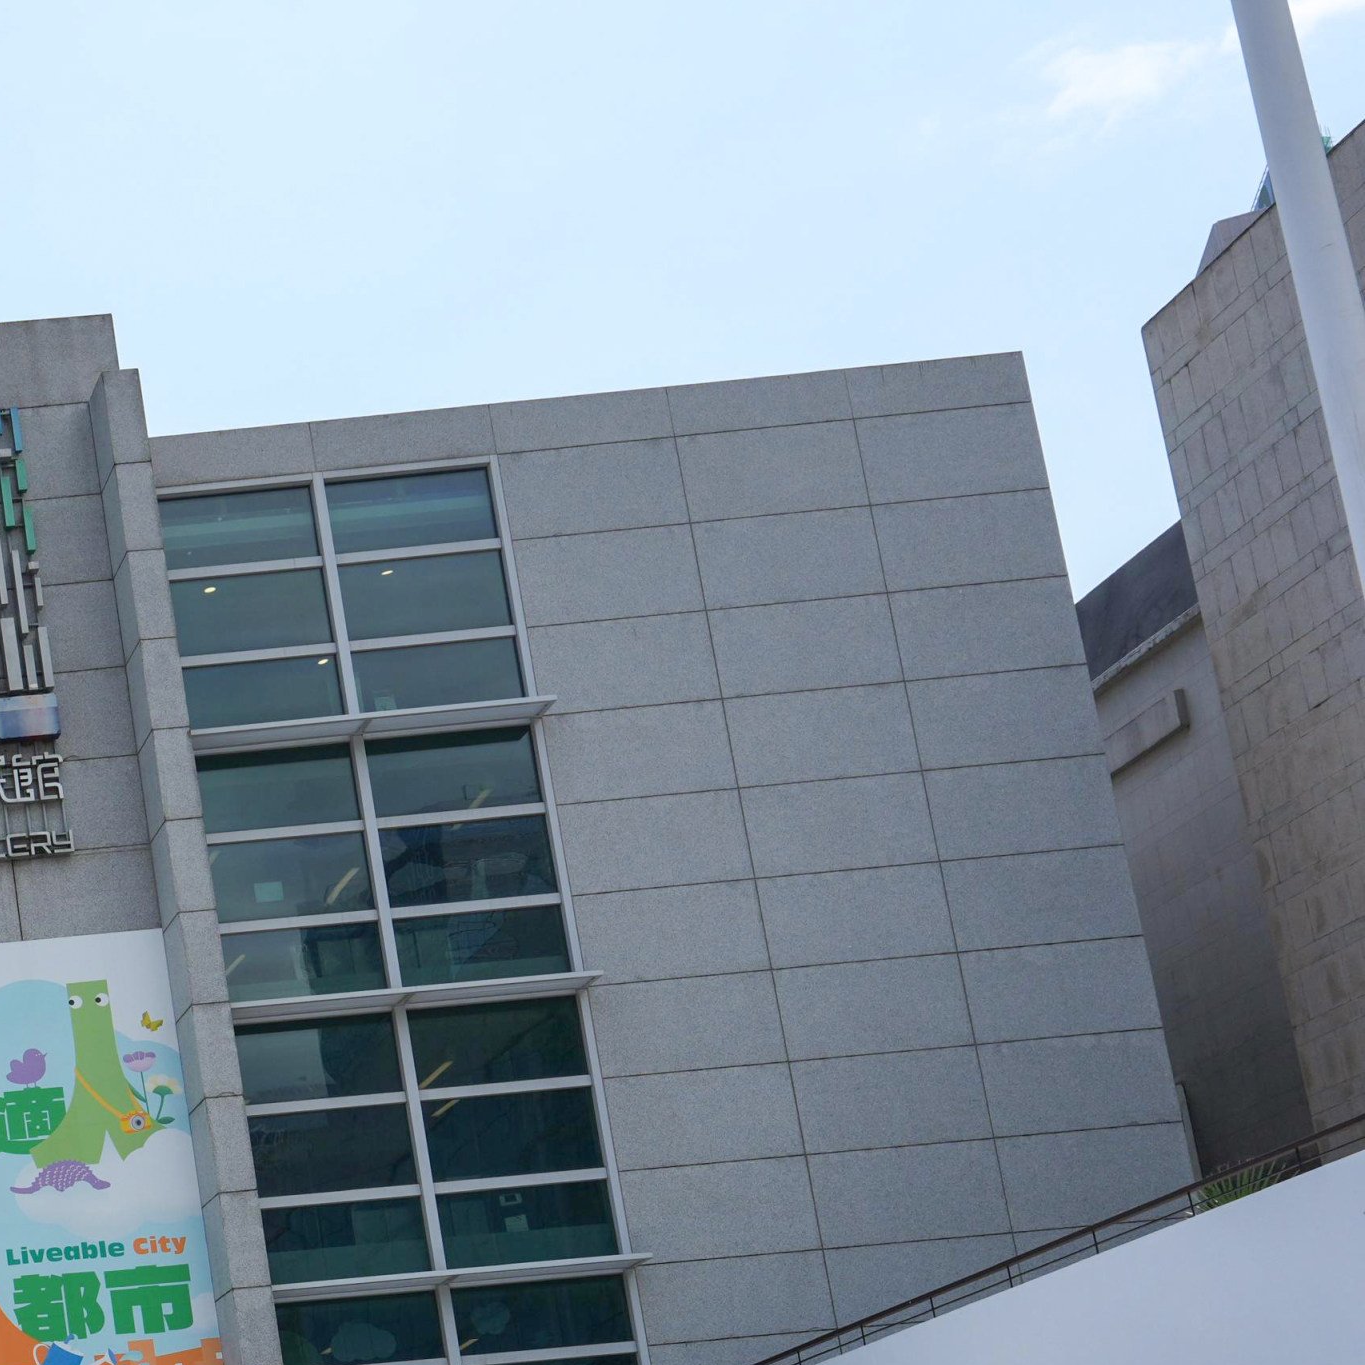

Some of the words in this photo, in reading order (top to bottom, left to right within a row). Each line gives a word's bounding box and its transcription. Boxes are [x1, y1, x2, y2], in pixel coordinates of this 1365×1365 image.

[6, 1239, 125, 1266] Liveable
[132, 1235, 187, 1256] City
[13, 1264, 194, 1342] 都市
